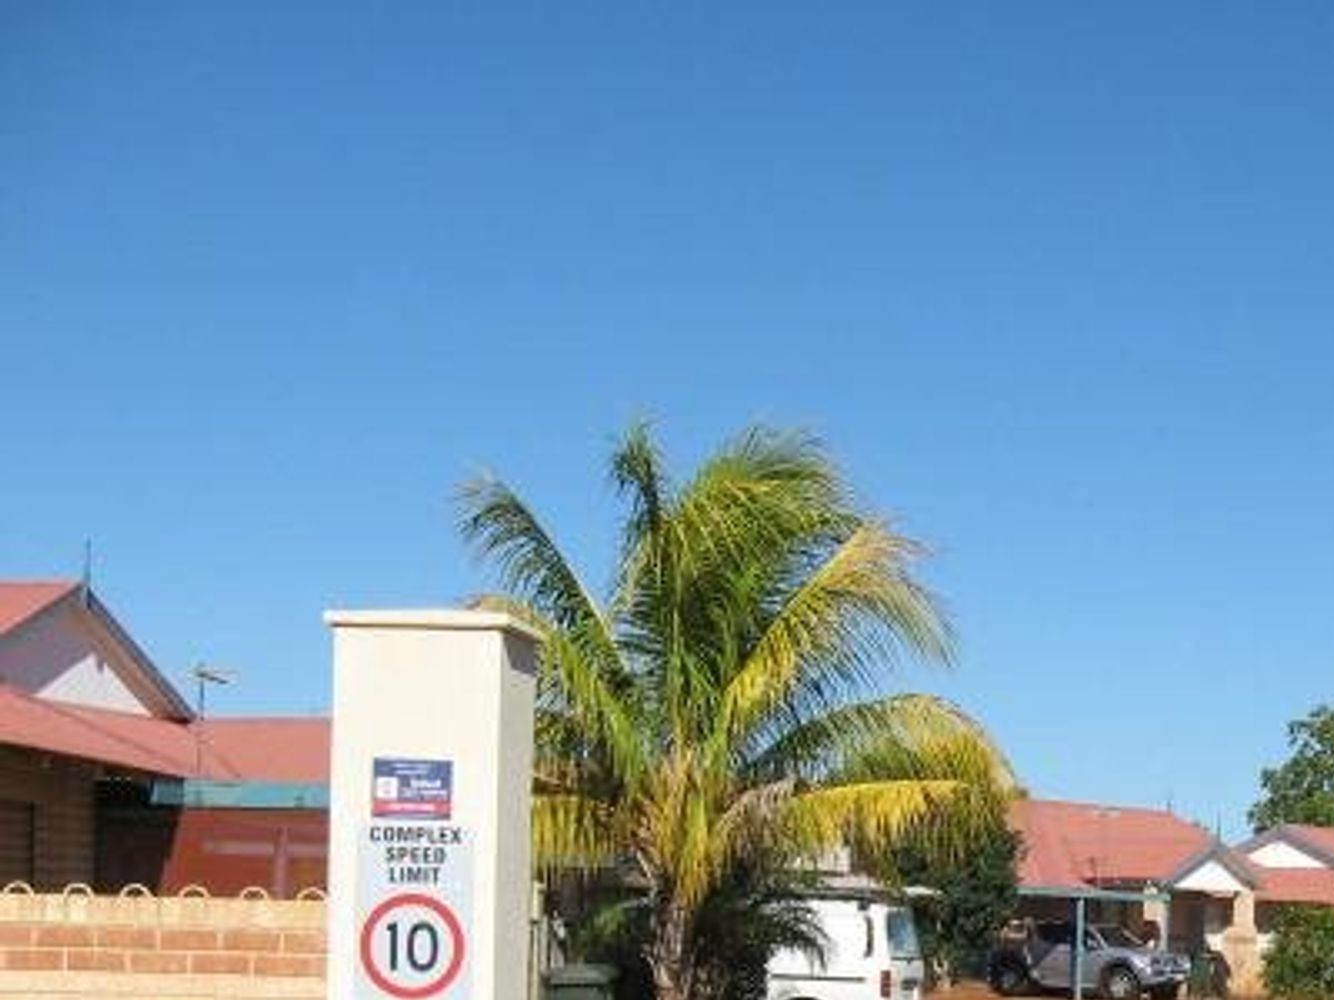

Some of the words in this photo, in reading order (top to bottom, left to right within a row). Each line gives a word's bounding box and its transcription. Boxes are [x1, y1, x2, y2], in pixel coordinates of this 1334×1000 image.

[370, 826, 462, 844] COMPLEX
[385, 847, 446, 864] SPEED
[388, 867, 441, 884] LIMIT
[386, 922, 439, 972] 10
